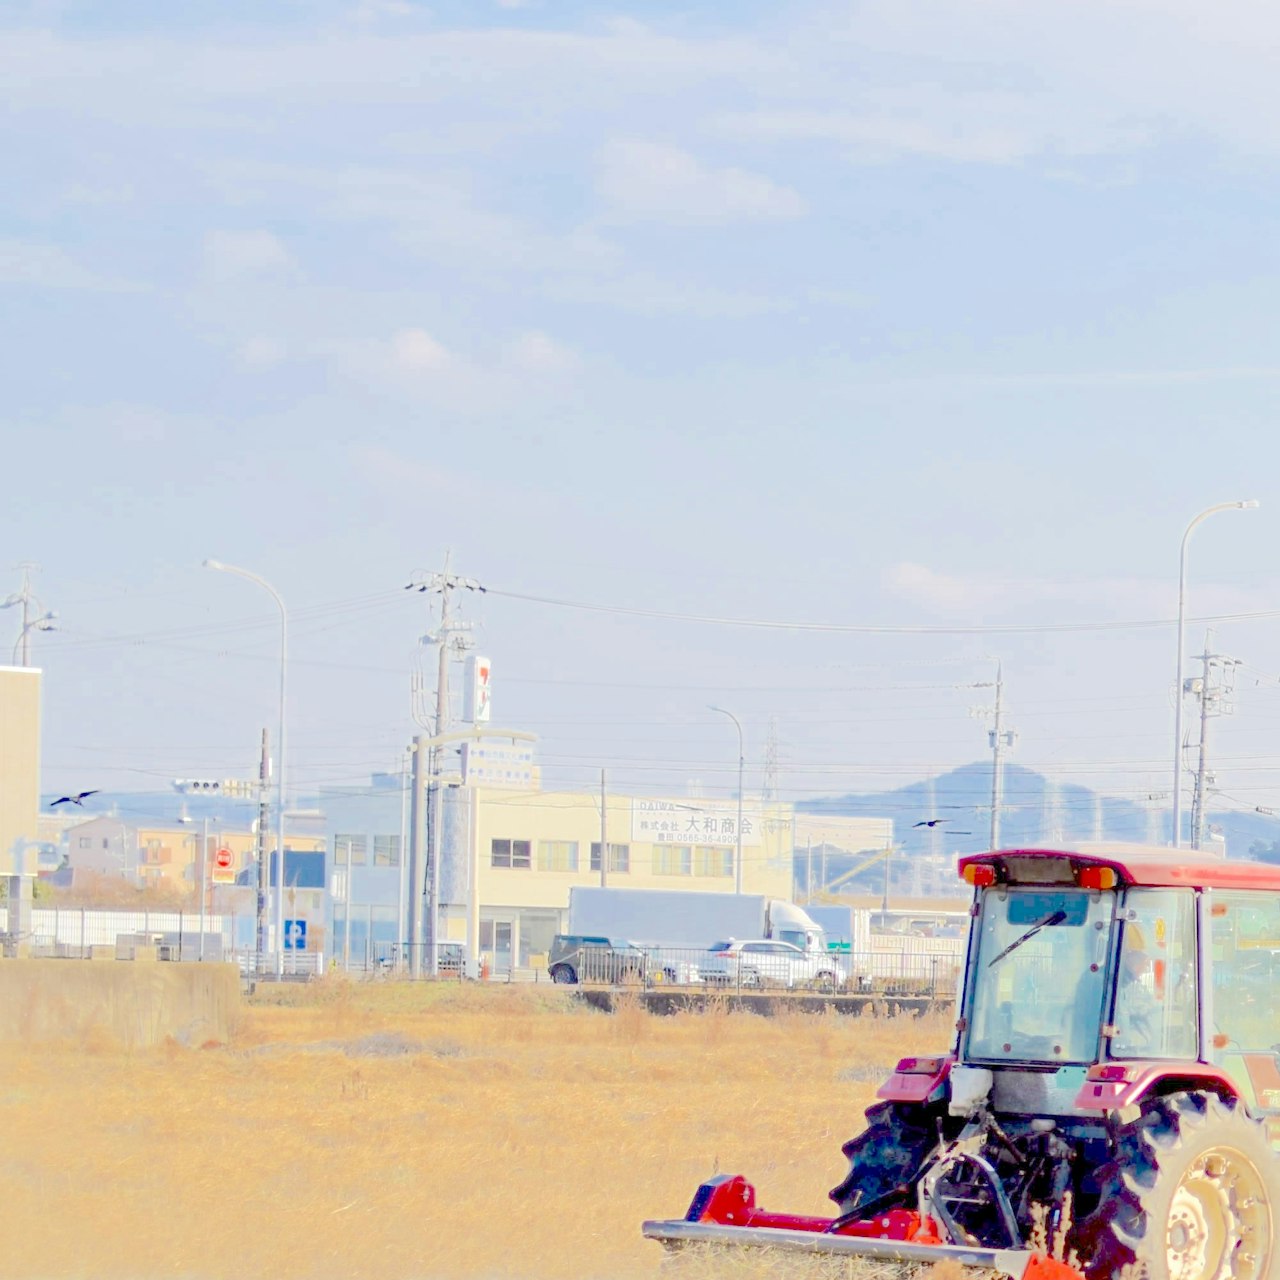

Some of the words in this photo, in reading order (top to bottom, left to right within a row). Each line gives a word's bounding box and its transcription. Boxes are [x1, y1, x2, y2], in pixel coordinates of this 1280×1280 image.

[640, 821, 679, 832] 株式会社
[686, 816, 753, 835] 大和商会
